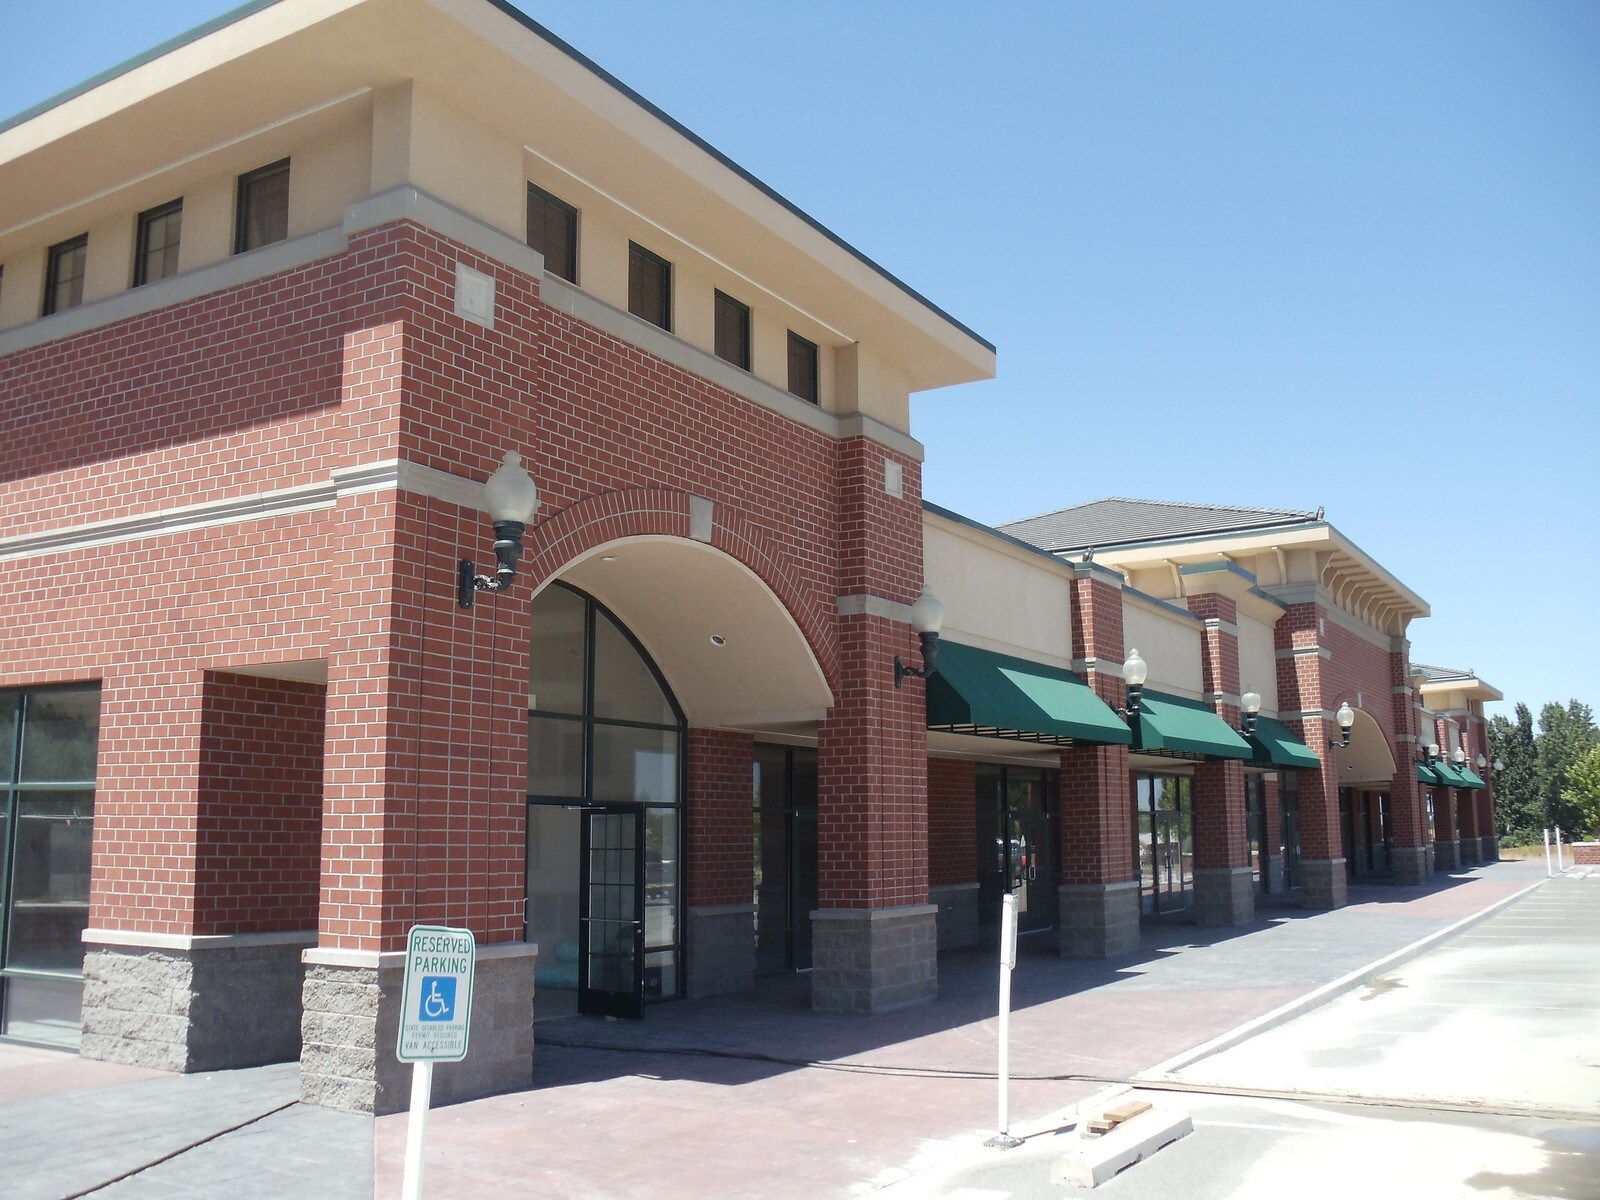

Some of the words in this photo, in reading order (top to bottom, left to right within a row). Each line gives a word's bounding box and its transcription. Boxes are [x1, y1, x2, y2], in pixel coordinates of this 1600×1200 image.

[413, 936, 471, 954] RESERVED
[414, 956, 467, 974] PARKING
[411, 1031, 431, 1039] PERMIT
[433, 1031, 458, 1039] REQUIRED
[405, 1041, 419, 1050] VAN
[422, 1040, 463, 1050] ACCESSIBLE
